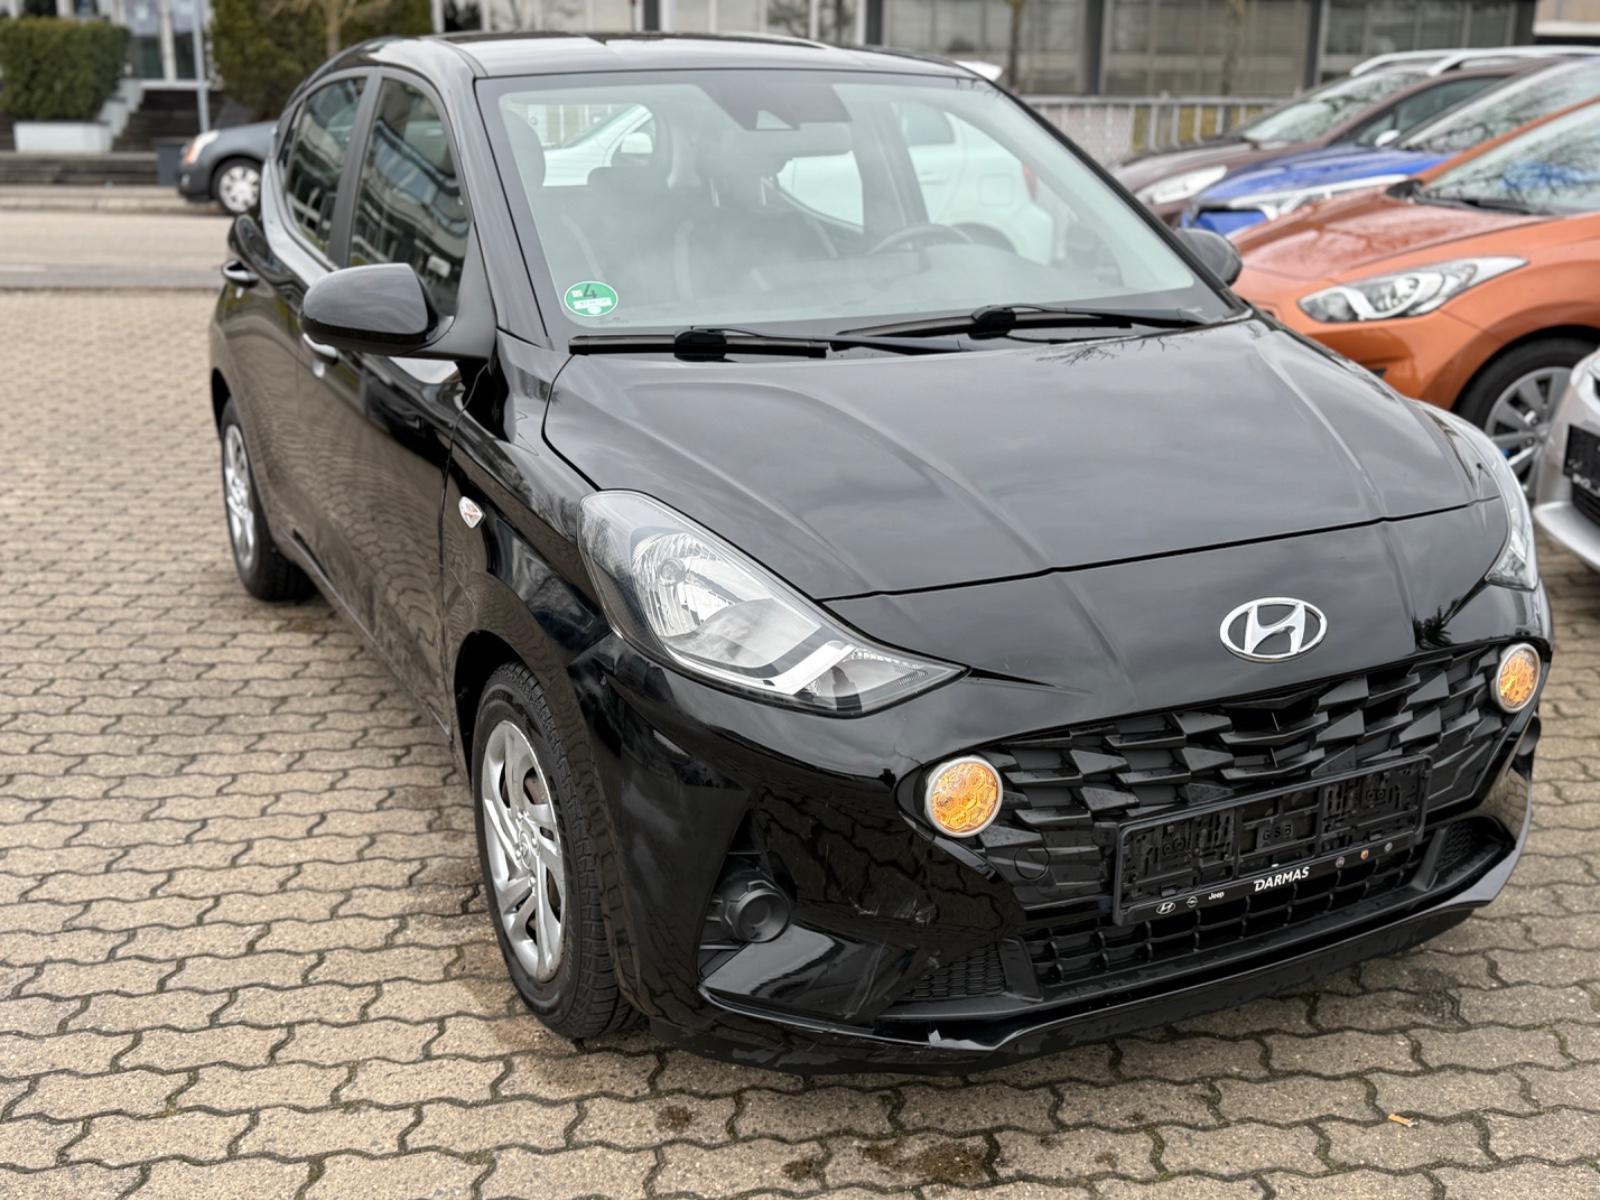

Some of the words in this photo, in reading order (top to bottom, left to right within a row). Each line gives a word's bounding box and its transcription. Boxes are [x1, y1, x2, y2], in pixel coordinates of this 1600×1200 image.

[583, 284, 598, 298] 4
[1253, 866, 1310, 892] DARMAS
[1208, 891, 1225, 900] Jeep
